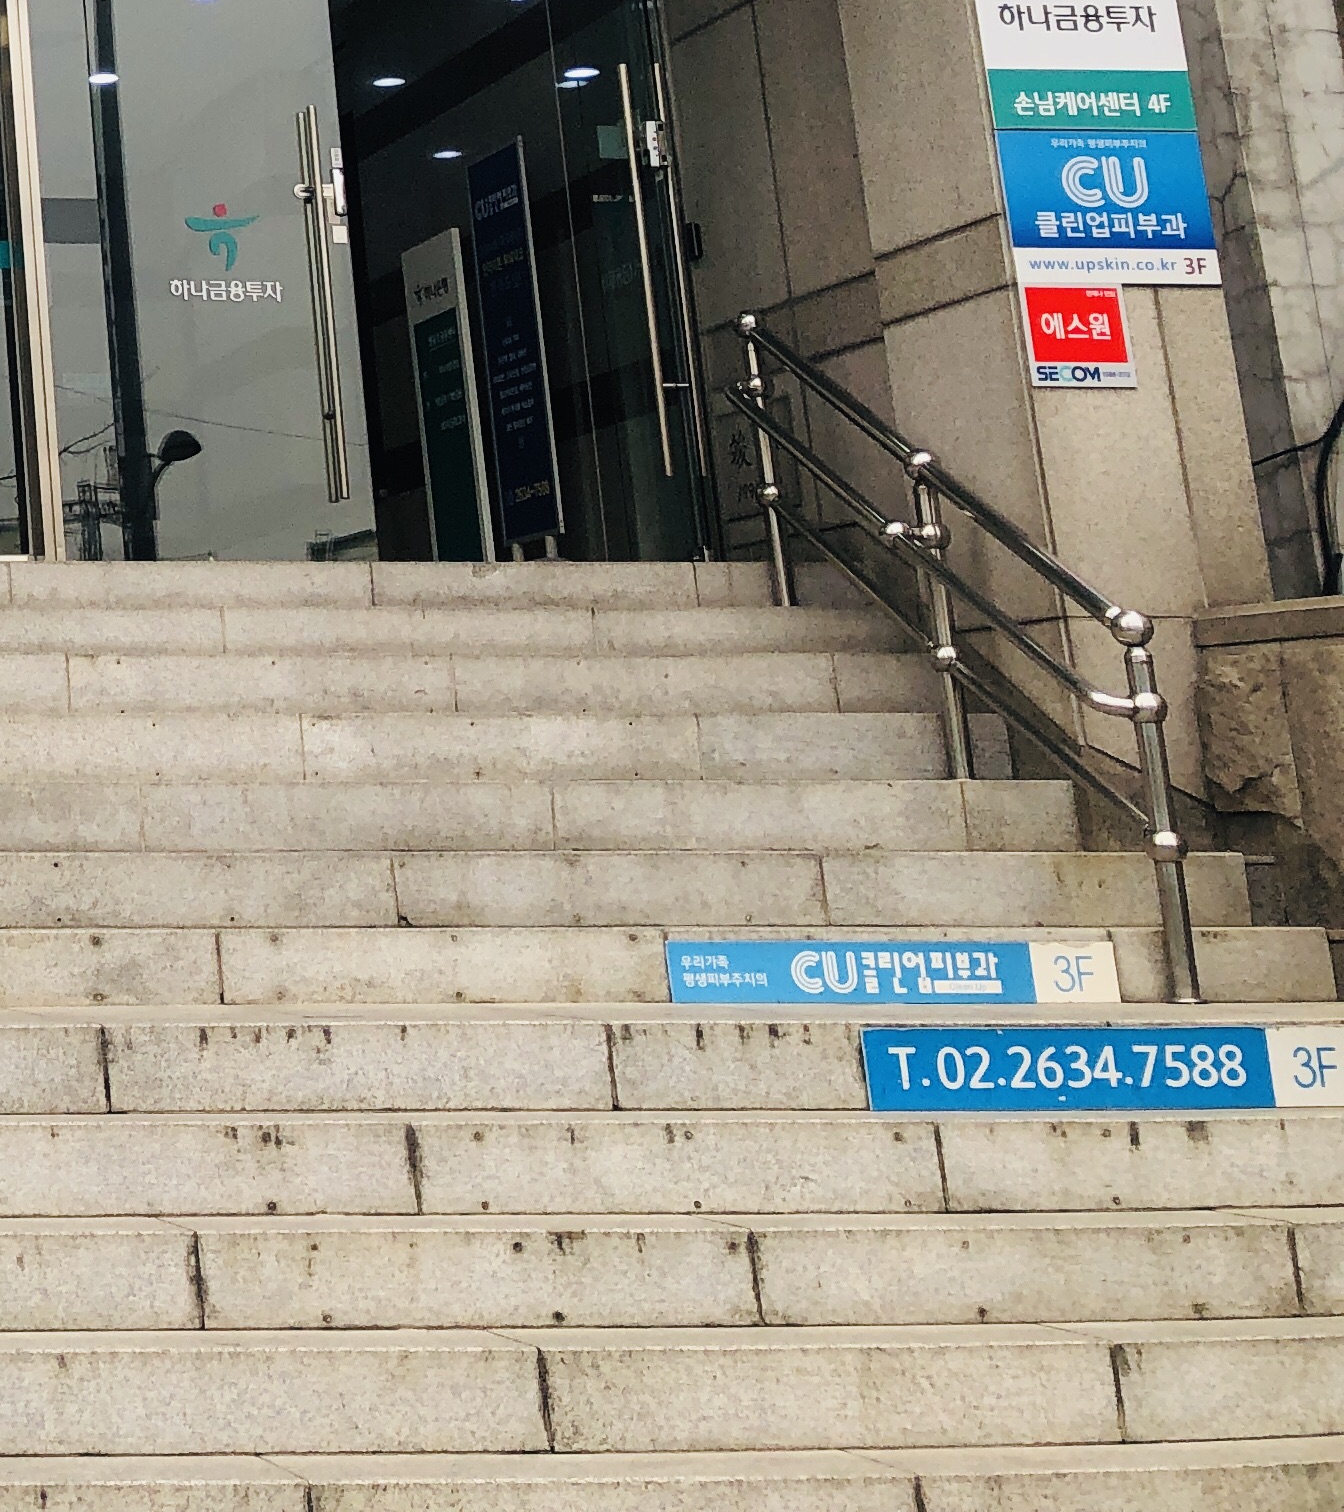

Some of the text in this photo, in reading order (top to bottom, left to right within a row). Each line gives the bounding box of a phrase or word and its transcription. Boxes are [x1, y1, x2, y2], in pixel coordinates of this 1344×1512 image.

[997, 3, 1157, 33] 하나금융투자
[1014, 91, 1171, 116] 손님케어센터 4F
[1062, 155, 1149, 208] CU
[1035, 211, 1187, 239] 클린업피부과
[1029, 257, 1208, 275] www.upskin.co.kr 3F
[169, 278, 283, 303] 하나금융투자
[1040, 312, 1112, 340] 에스원
[1036, 365, 1101, 382] SECOM
[680, 955, 730, 970] 우리가족
[790, 950, 858, 994] CU
[861, 951, 999, 994] 클린업피부과
[1053, 955, 1095, 992] 3F
[683, 972, 768, 987] 평생피부주치의
[1292, 1045, 1339, 1089] 3F
